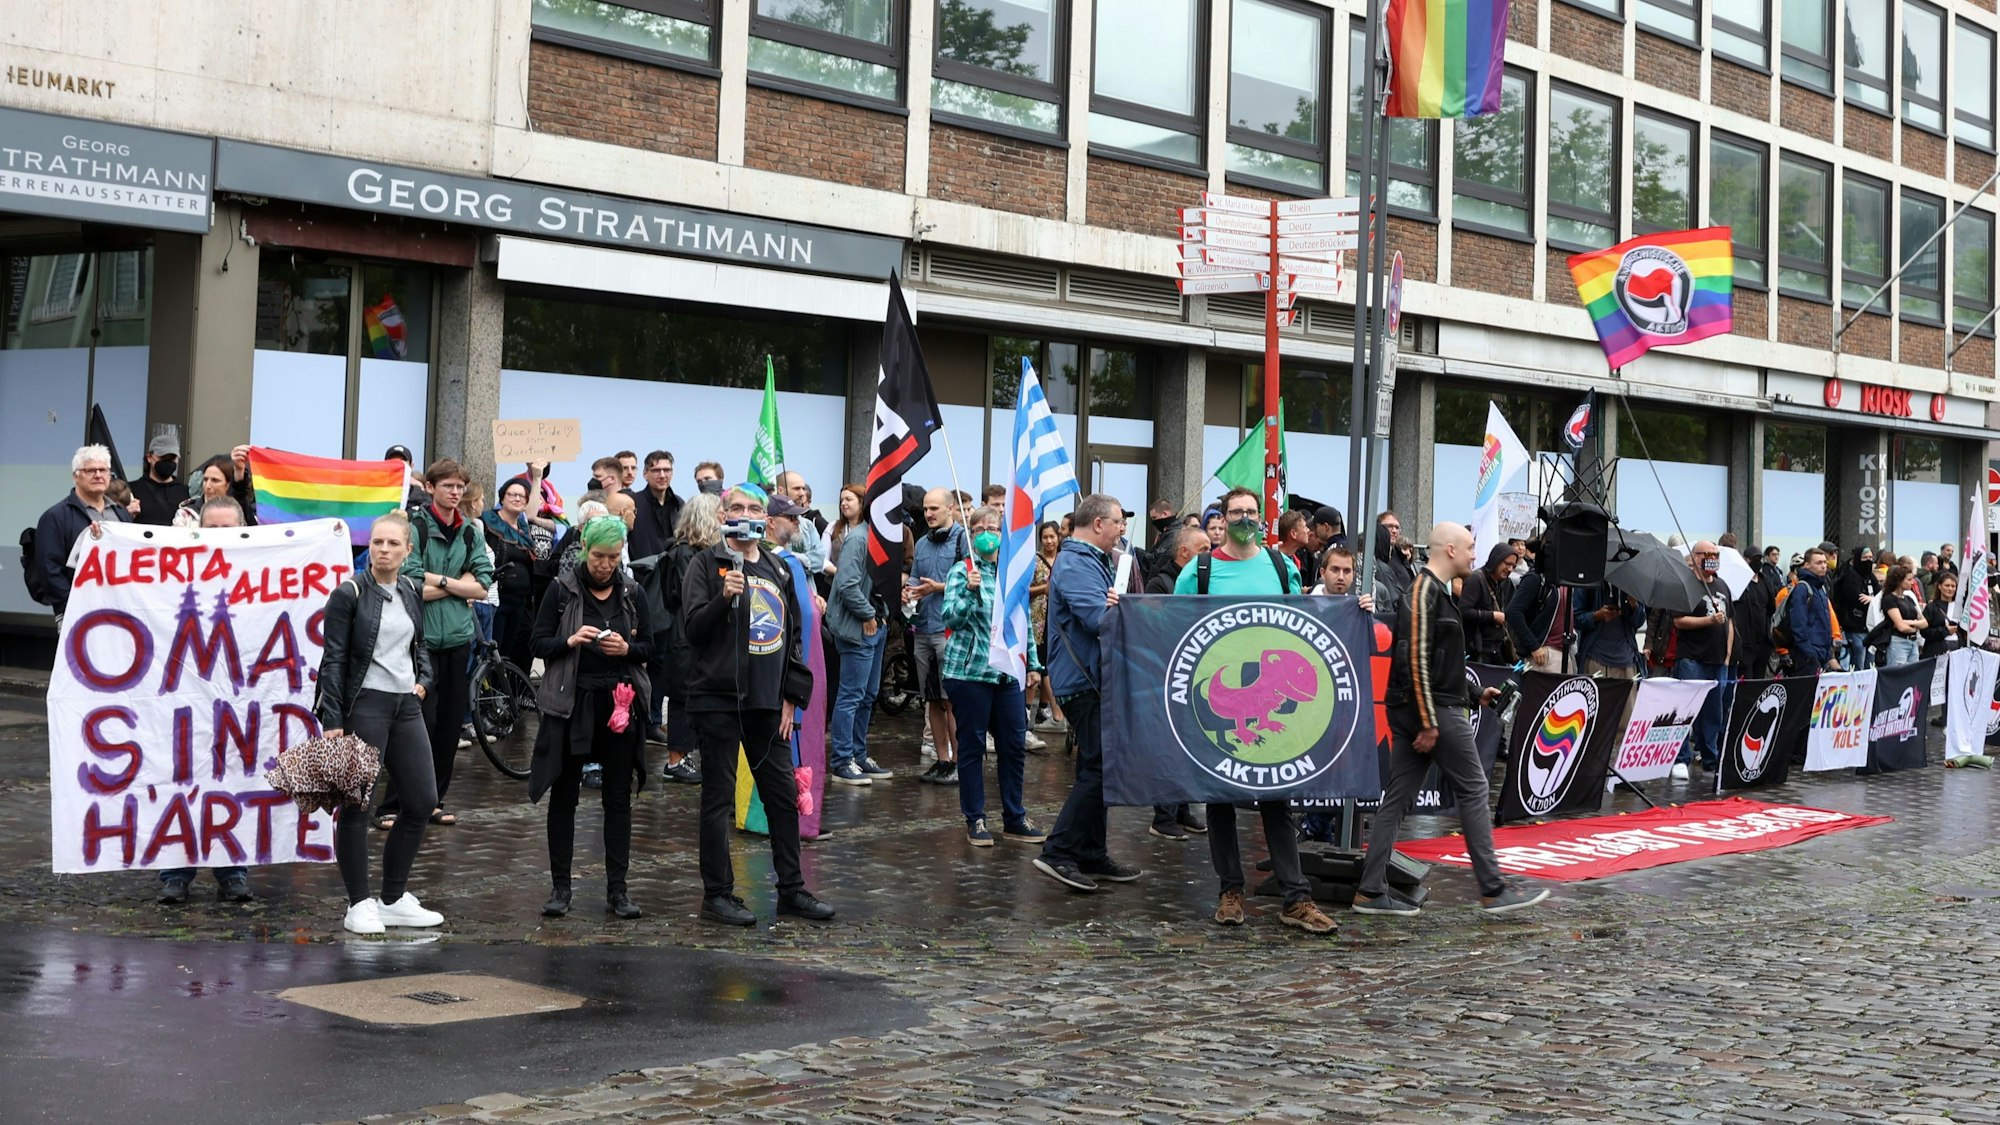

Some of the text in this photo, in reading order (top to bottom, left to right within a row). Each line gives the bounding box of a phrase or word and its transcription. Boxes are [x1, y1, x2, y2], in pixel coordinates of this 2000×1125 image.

[62, 135, 130, 156] GEORG
[1, 148, 206, 191] TRATHMANN
[0, 175, 198, 210] ERRENAUSSTATTER
[1288, 203, 1311, 213] Rhein
[347, 168, 814, 264] GEORG STRATHMANN
[1288, 221, 1312, 232] Deutz
[1288, 237, 1347, 250] Deutzer Brücke
[1194, 281, 1229, 291] Gürzenich
[1861, 383, 1913, 417] KIOSK
[538, 422, 560, 436] Pride
[1858, 454, 1876, 534] KIOSK
[1878, 453, 1888, 533] KIOSK
[74, 545, 350, 606] ALERTA ALERT
[1171, 607, 1353, 705] ANTIVERSCHWURBELTE
[1543, 679, 1596, 720] ANTIHOMOPHOBE
[77, 698, 323, 796] SIND
[1625, 720, 1652, 745] EIN
[1215, 754, 1317, 785] AKTION
[1526, 792, 1556, 811] AKTION
[82, 785, 337, 868] HÄRTE
